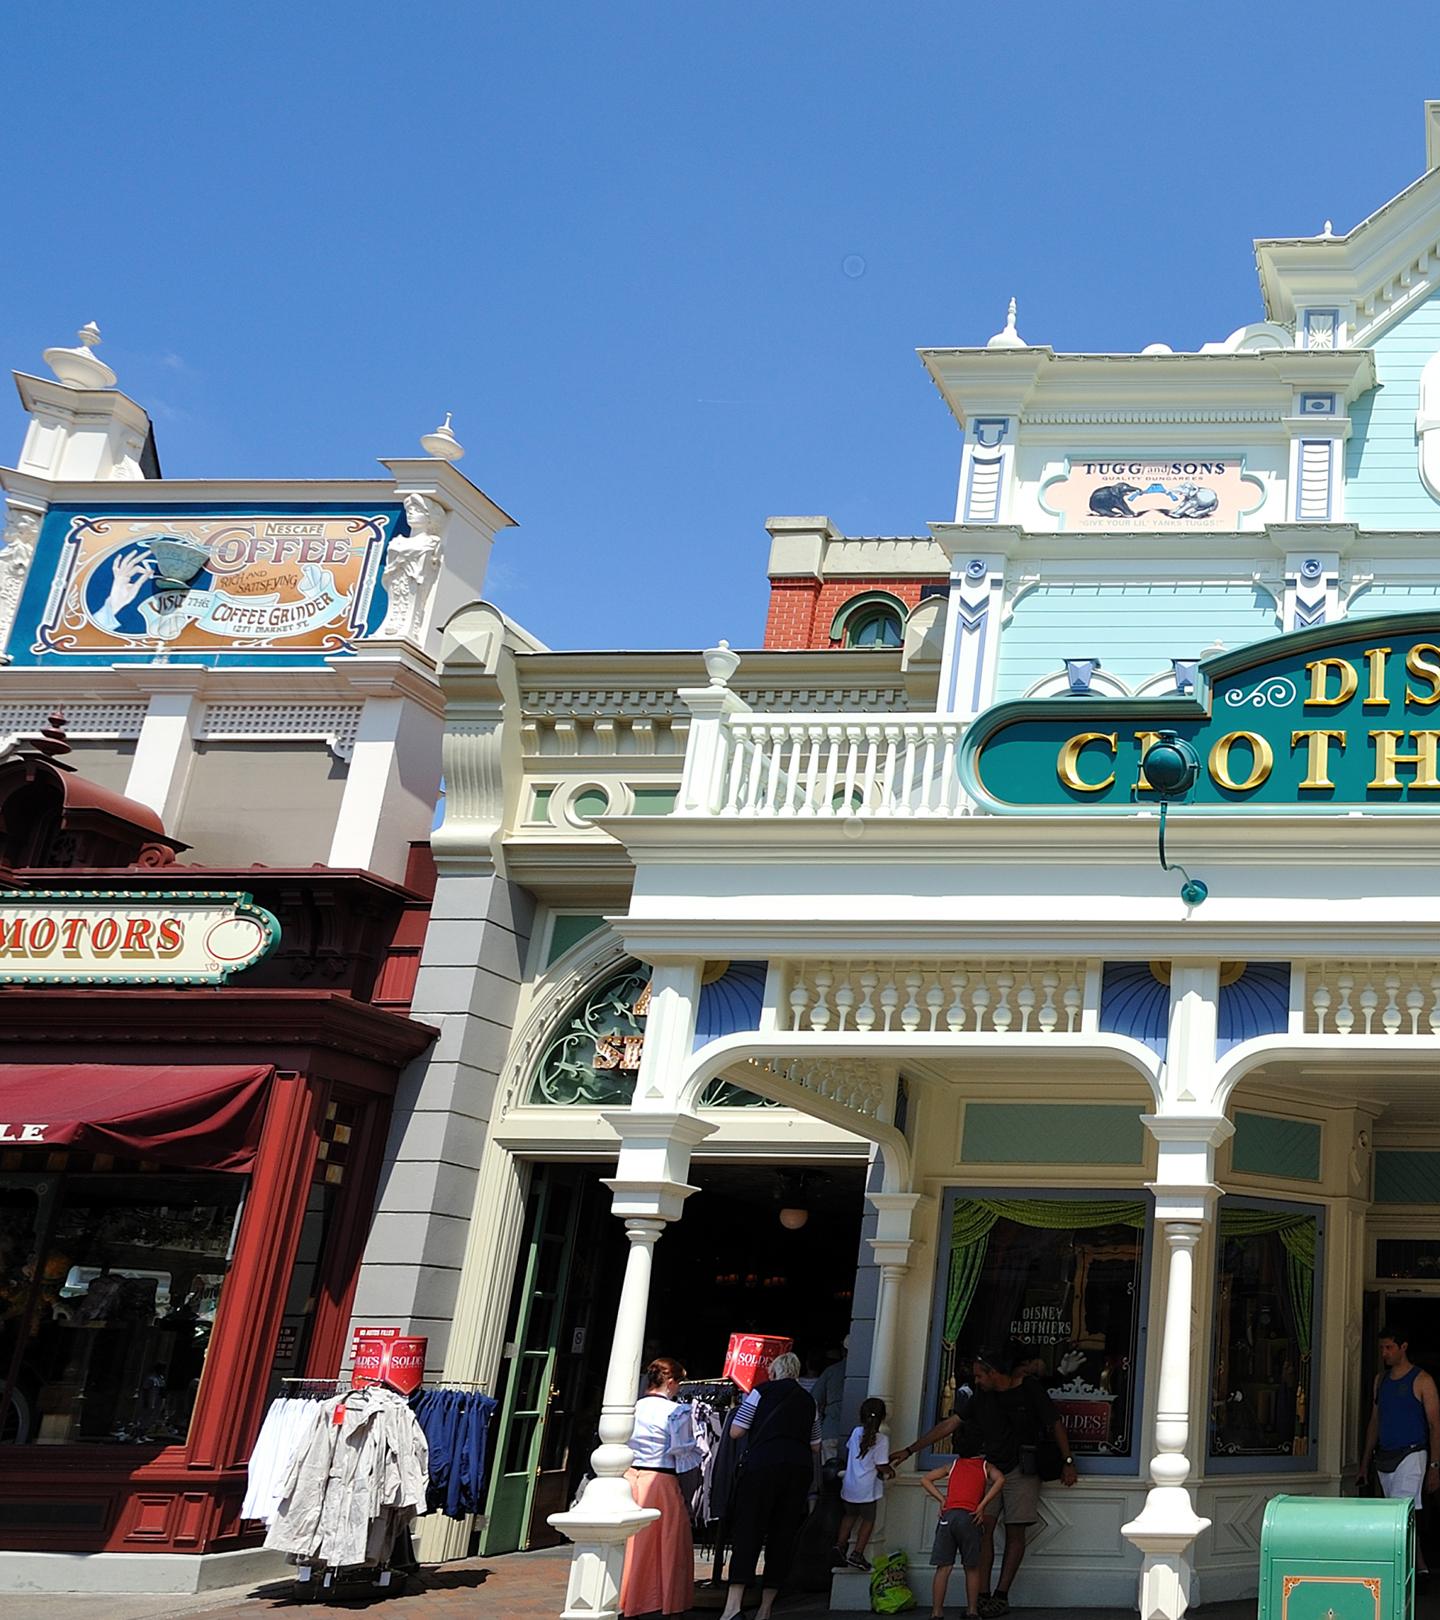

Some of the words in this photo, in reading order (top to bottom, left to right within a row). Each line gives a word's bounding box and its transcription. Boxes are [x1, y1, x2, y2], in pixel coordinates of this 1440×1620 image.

[1083, 463, 1141, 475] TUGG
[1171, 463, 1225, 475] SONS
[202, 525, 351, 576] COFFEE
[220, 574, 243, 589] RICH
[246, 570, 267, 578] AND
[151, 595, 188, 614] VISIT
[211, 603, 267, 625] COFFEE
[268, 593, 334, 626] GRINDER
[255, 624, 293, 633] MARKET
[0, 917, 182, 951] MOTORS
[1022, 1306, 1063, 1320] DISNEY
[1010, 1321, 1072, 1334] CLOTHIERS
